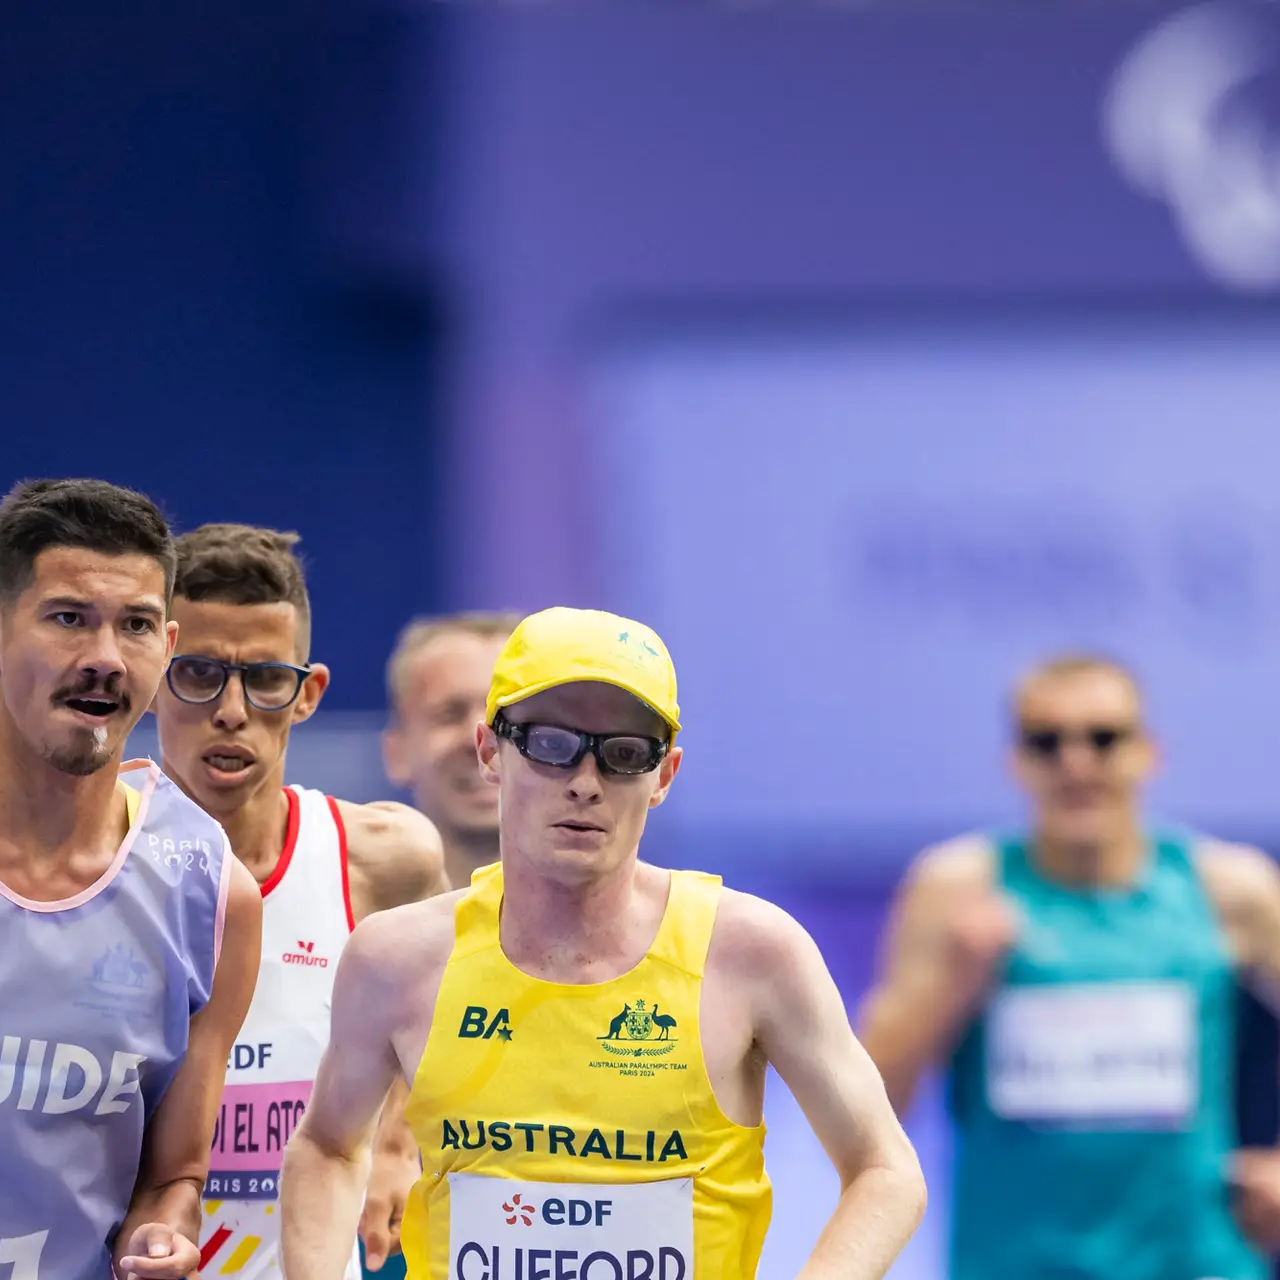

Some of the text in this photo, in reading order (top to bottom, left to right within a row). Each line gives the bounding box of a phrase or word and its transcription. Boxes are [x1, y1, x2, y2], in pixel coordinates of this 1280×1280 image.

[282, 953, 329, 968] amura
[458, 1006, 513, 1043] BA
[227, 1043, 272, 1070] DF
[588, 1061, 628, 1069] AUSTRALIAN
[629, 1062, 669, 1070] PARALYMPIC
[619, 1069, 638, 1077] PARIS
[234, 1103, 259, 1153] EL
[441, 1118, 689, 1162] AUSTRALIA
[249, 1178, 280, 1193] 20
